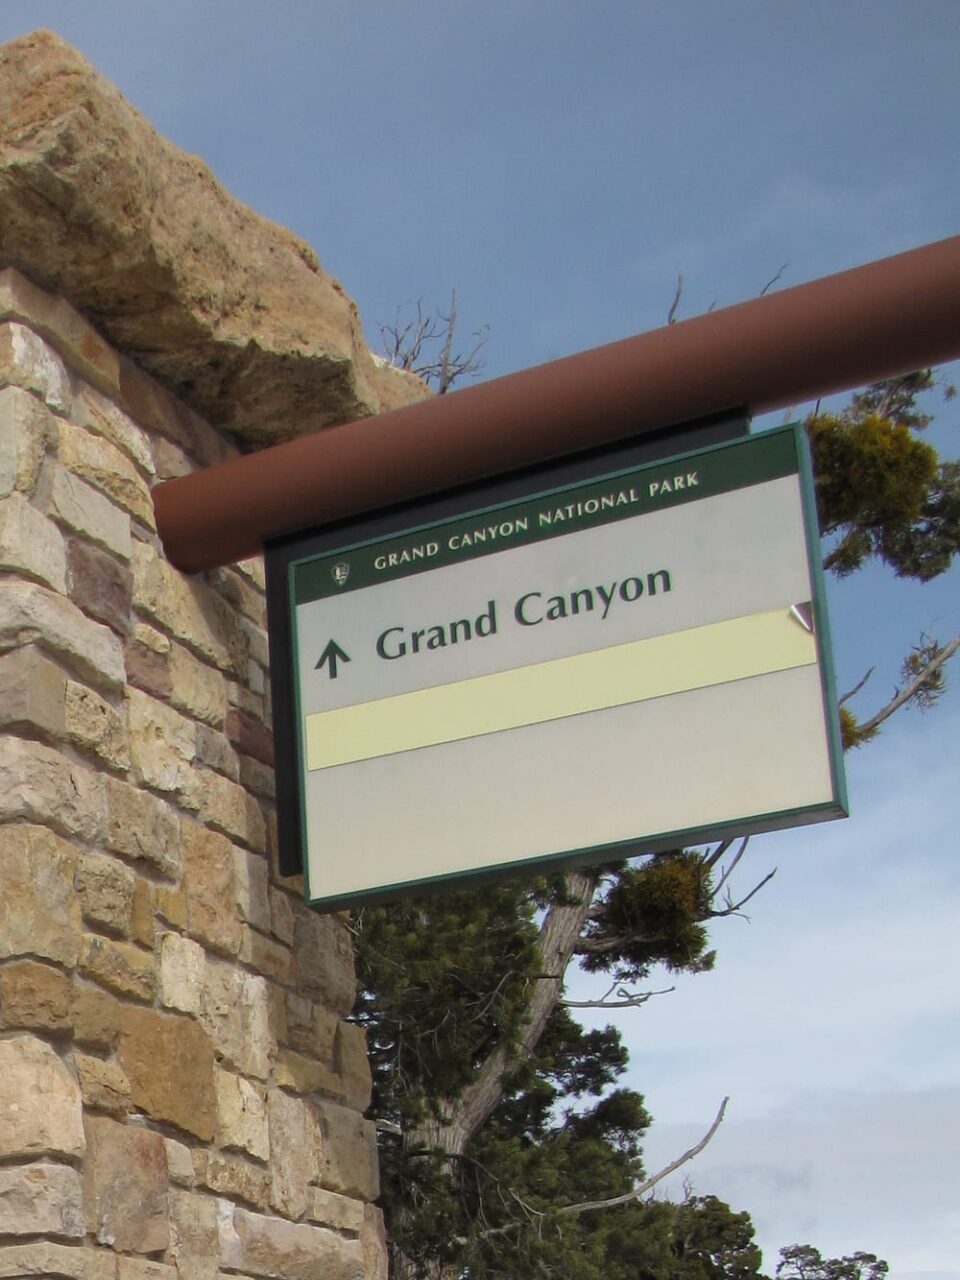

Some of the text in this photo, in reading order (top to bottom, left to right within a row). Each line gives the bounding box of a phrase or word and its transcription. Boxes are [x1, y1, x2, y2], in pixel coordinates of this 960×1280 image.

[374, 471, 699, 570] GRAND CANYON NATIONAL PARK
[375, 568, 672, 661] Grand Canyon
